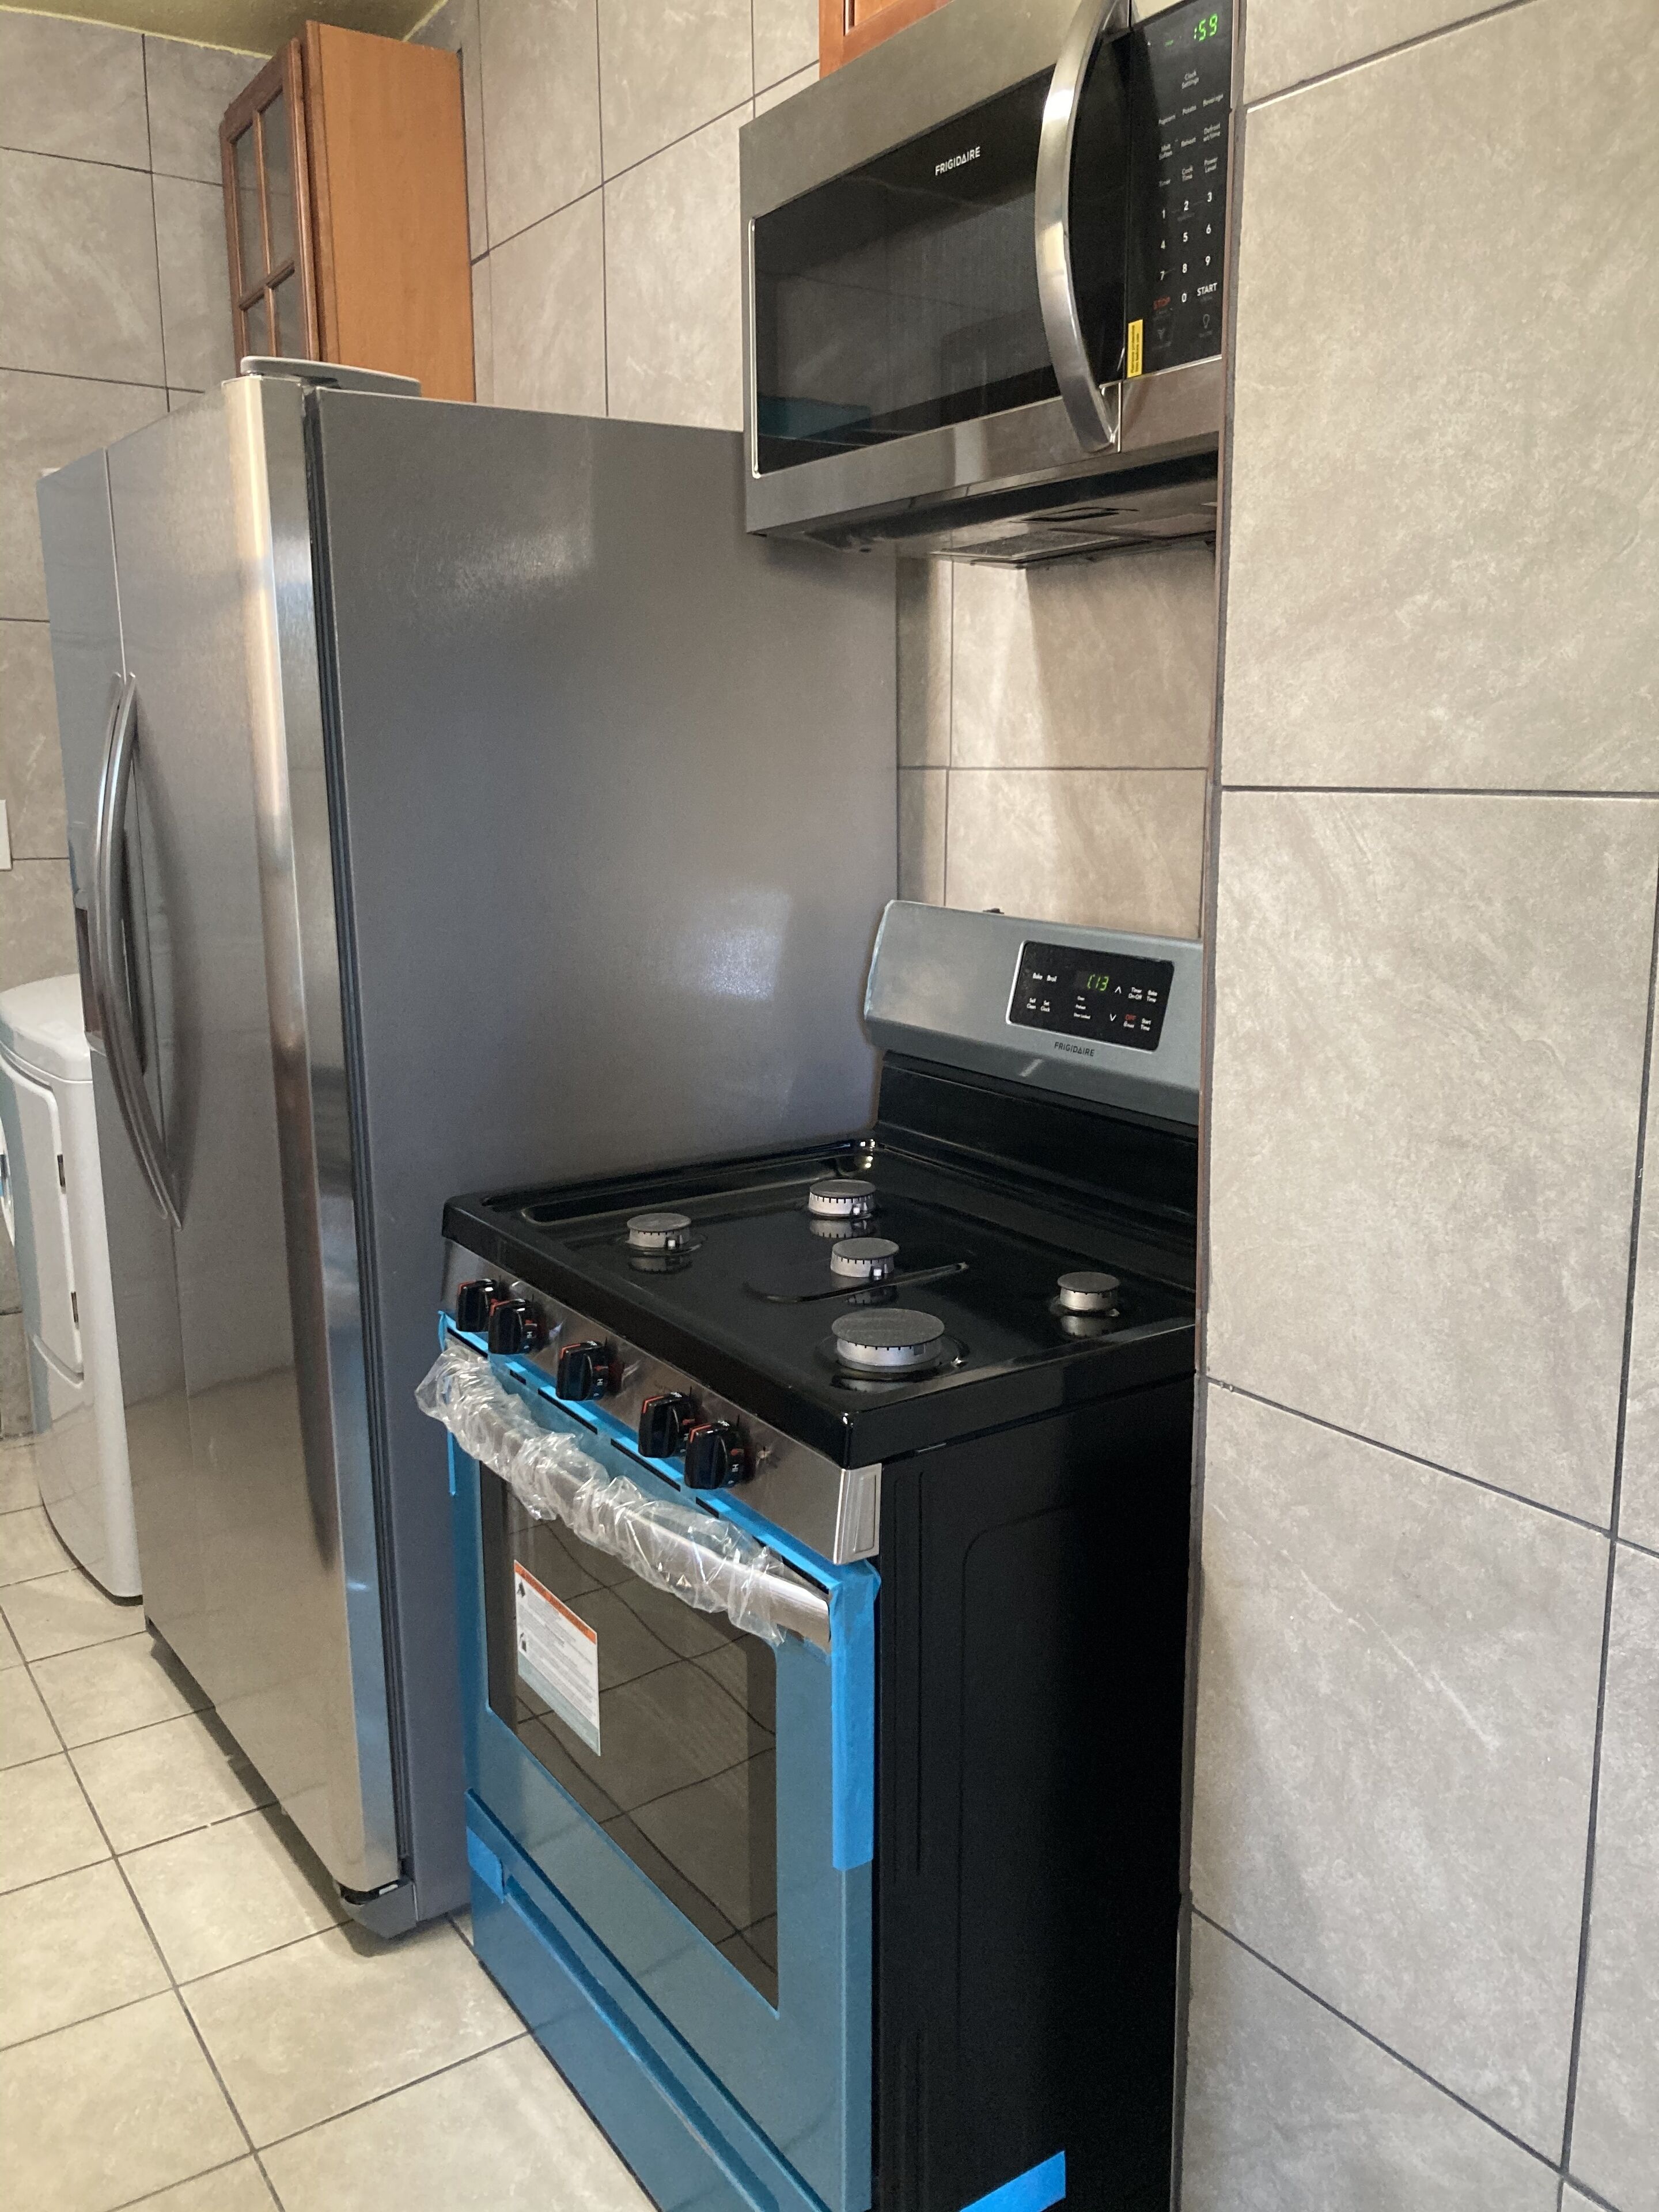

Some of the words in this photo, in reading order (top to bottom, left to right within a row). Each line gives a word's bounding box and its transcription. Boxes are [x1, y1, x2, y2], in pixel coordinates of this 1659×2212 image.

[935, 146, 981, 176] FRIGIDAIRE
[1162, 209, 1166, 219] 1
[1184, 200, 1189, 211] 2
[1207, 191, 1213, 202] 3
[1160, 240, 1166, 249] 4
[1183, 232, 1188, 243] 5
[1206, 224, 1211, 234] 6
[1160, 270, 1165, 281] 7
[1182, 263, 1188, 274] 8
[1205, 255, 1211, 266] 9
[1181, 293, 1187, 303] 0
[1197, 283, 1218, 297] START
[1054, 1041, 1095, 1057] FRIGIDAIRE
